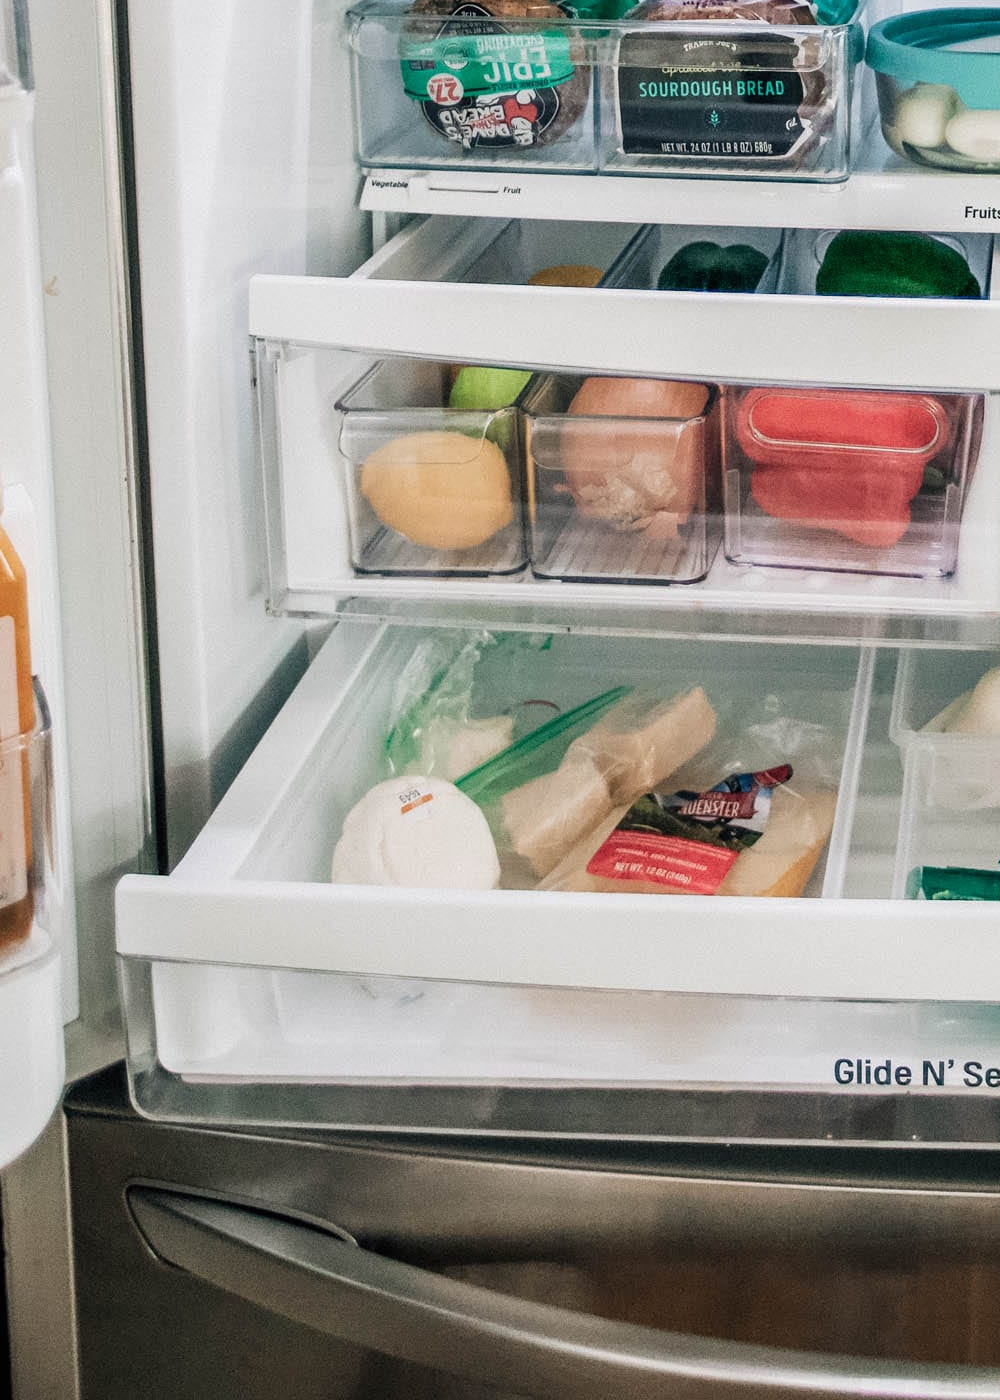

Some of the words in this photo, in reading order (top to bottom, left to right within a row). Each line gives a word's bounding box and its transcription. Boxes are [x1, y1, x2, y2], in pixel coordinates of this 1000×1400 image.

[683, 40, 713, 52] TRADER
[716, 40, 737, 52] JOE'S
[481, 45, 552, 83] EPIC
[639, 80, 733, 97] SOURDOUGH
[736, 80, 785, 96] BREAD
[438, 105, 506, 126] BREAD
[446, 123, 512, 141] DAVE'S
[661, 142, 675, 152] NET
[676, 142, 690, 153] WT.
[691, 143, 700, 152] 24
[701, 143, 711, 152] OZ
[722, 143, 732, 152] LB
[755, 141, 773, 154] 680g
[371, 179, 408, 188] Vegetable
[503, 185, 521, 195] Fruit
[614, 862, 629, 872] NET
[629, 863, 643, 874] WT.
[646, 866, 656, 875] 12
[656, 867, 667, 878] OZ
[666, 869, 692, 884] (340g)
[834, 1058, 912, 1086] Glide
[922, 1060, 955, 1087] N'
